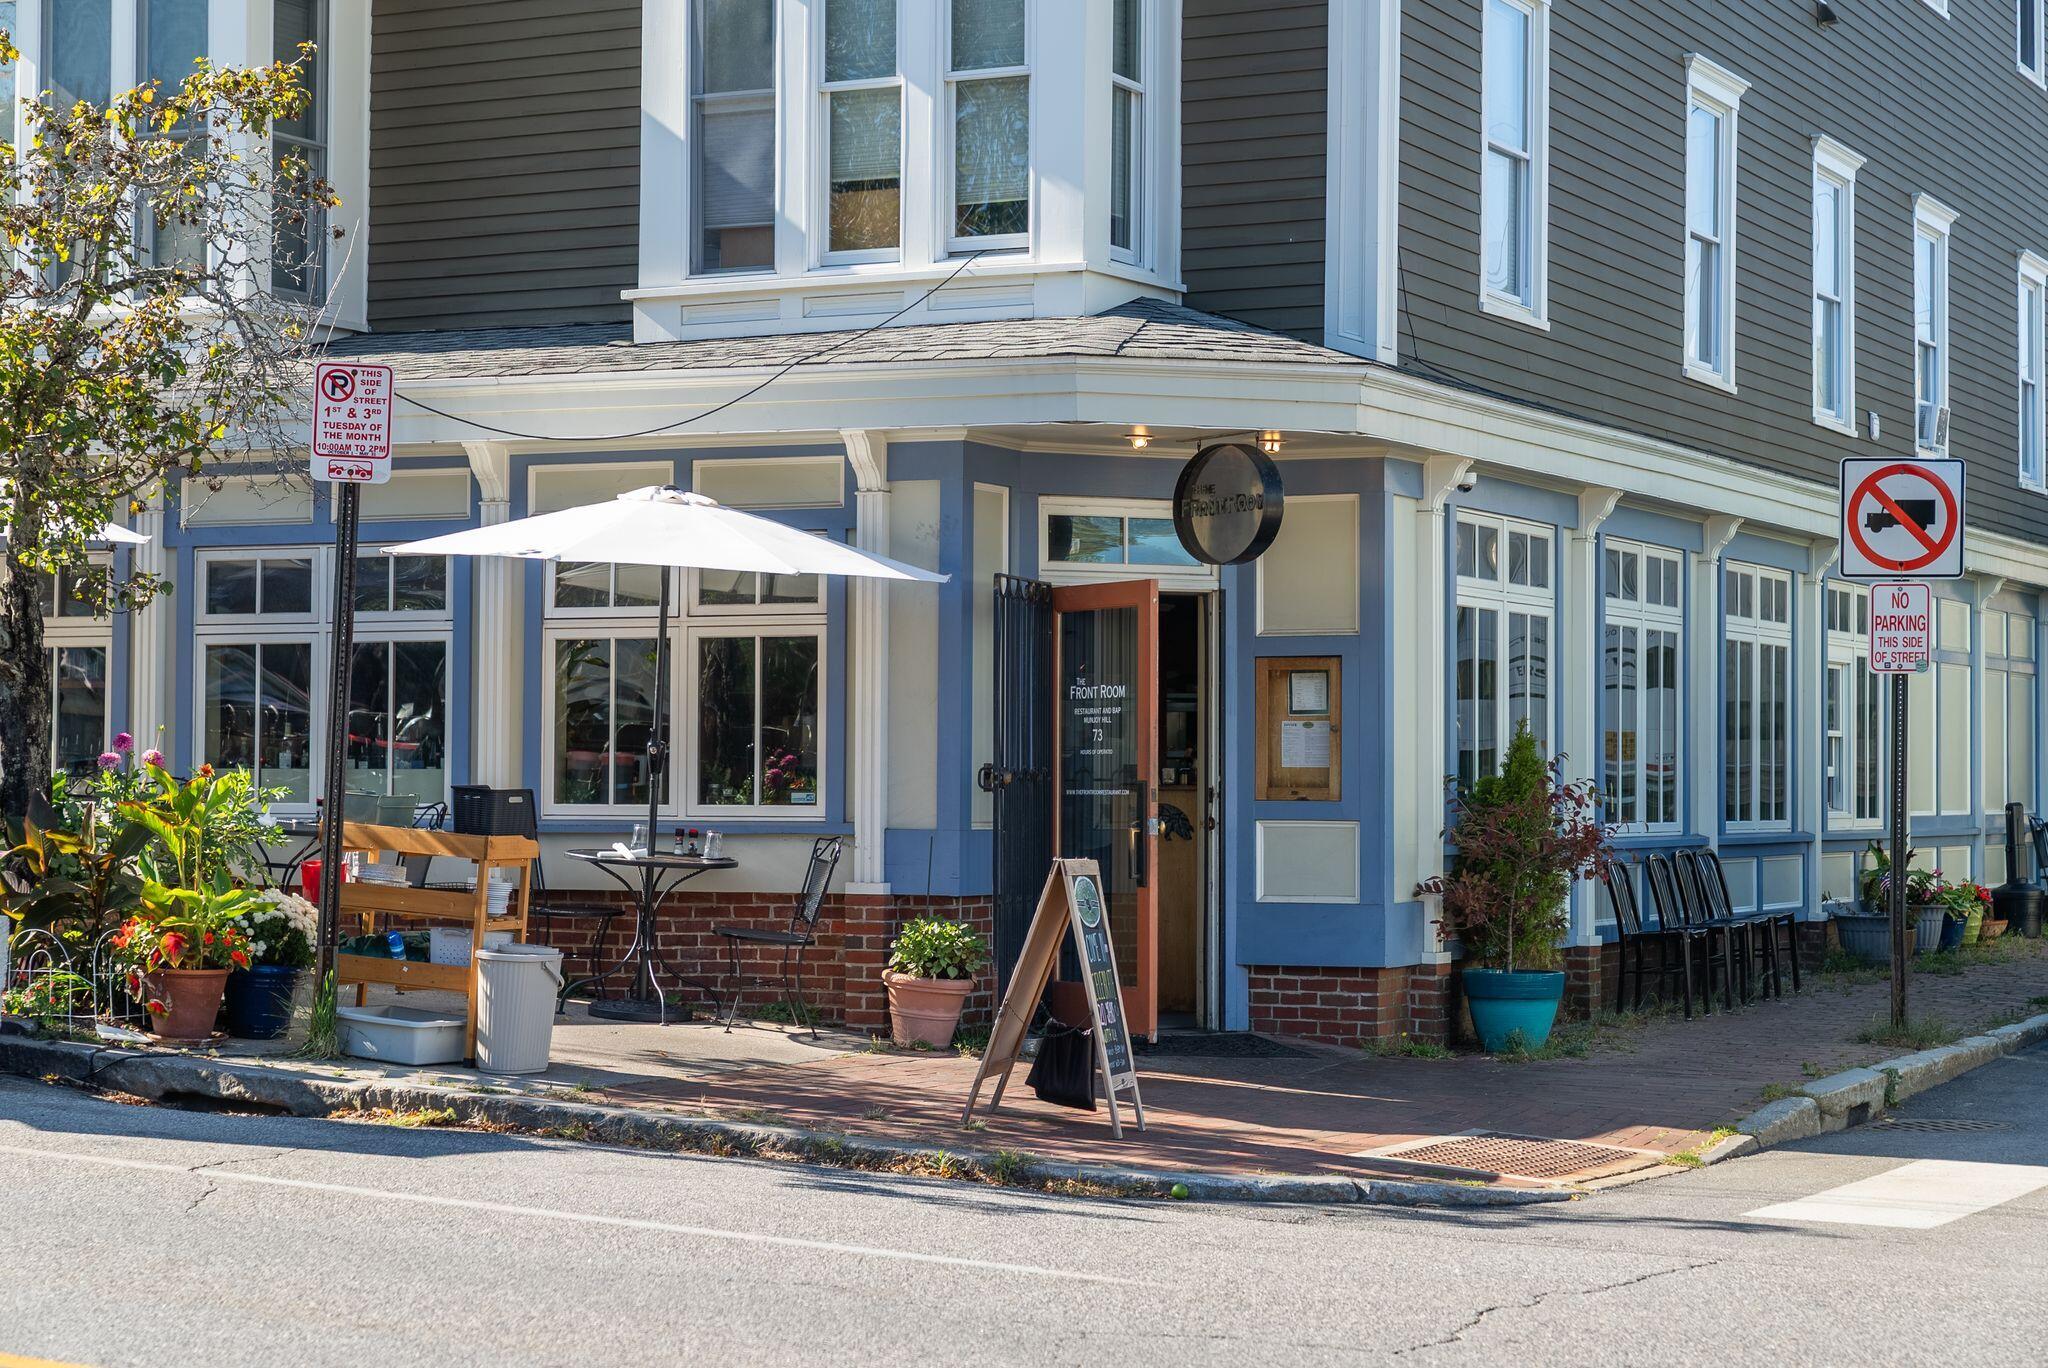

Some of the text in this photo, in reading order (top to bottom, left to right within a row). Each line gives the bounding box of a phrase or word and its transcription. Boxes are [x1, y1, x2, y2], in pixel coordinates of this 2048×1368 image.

[360, 370, 382, 378] THIS
[360, 379, 382, 387] SIDE
[364, 388, 377, 396] OF
[353, 396, 387, 405] STREET
[347, 407, 357, 419] &
[363, 408, 382, 420] 3RD
[323, 421, 383, 432] TUESDAY OF
[323, 431, 381, 442] THE MONTH
[317, 442, 386, 454] 10:00AM TO 2PM
[1891, 592, 1910, 609] NO
[1874, 615, 1926, 632] PARKING
[1878, 636, 1923, 648] THIS SIDE
[1874, 651, 1926, 664] OF STREET
[1070, 684, 1126, 700] FRONT ROOM
[1074, 707, 1102, 715] RESTAURANT
[1101, 716, 1112, 724] HILL
[1092, 728, 1103, 742] 73
